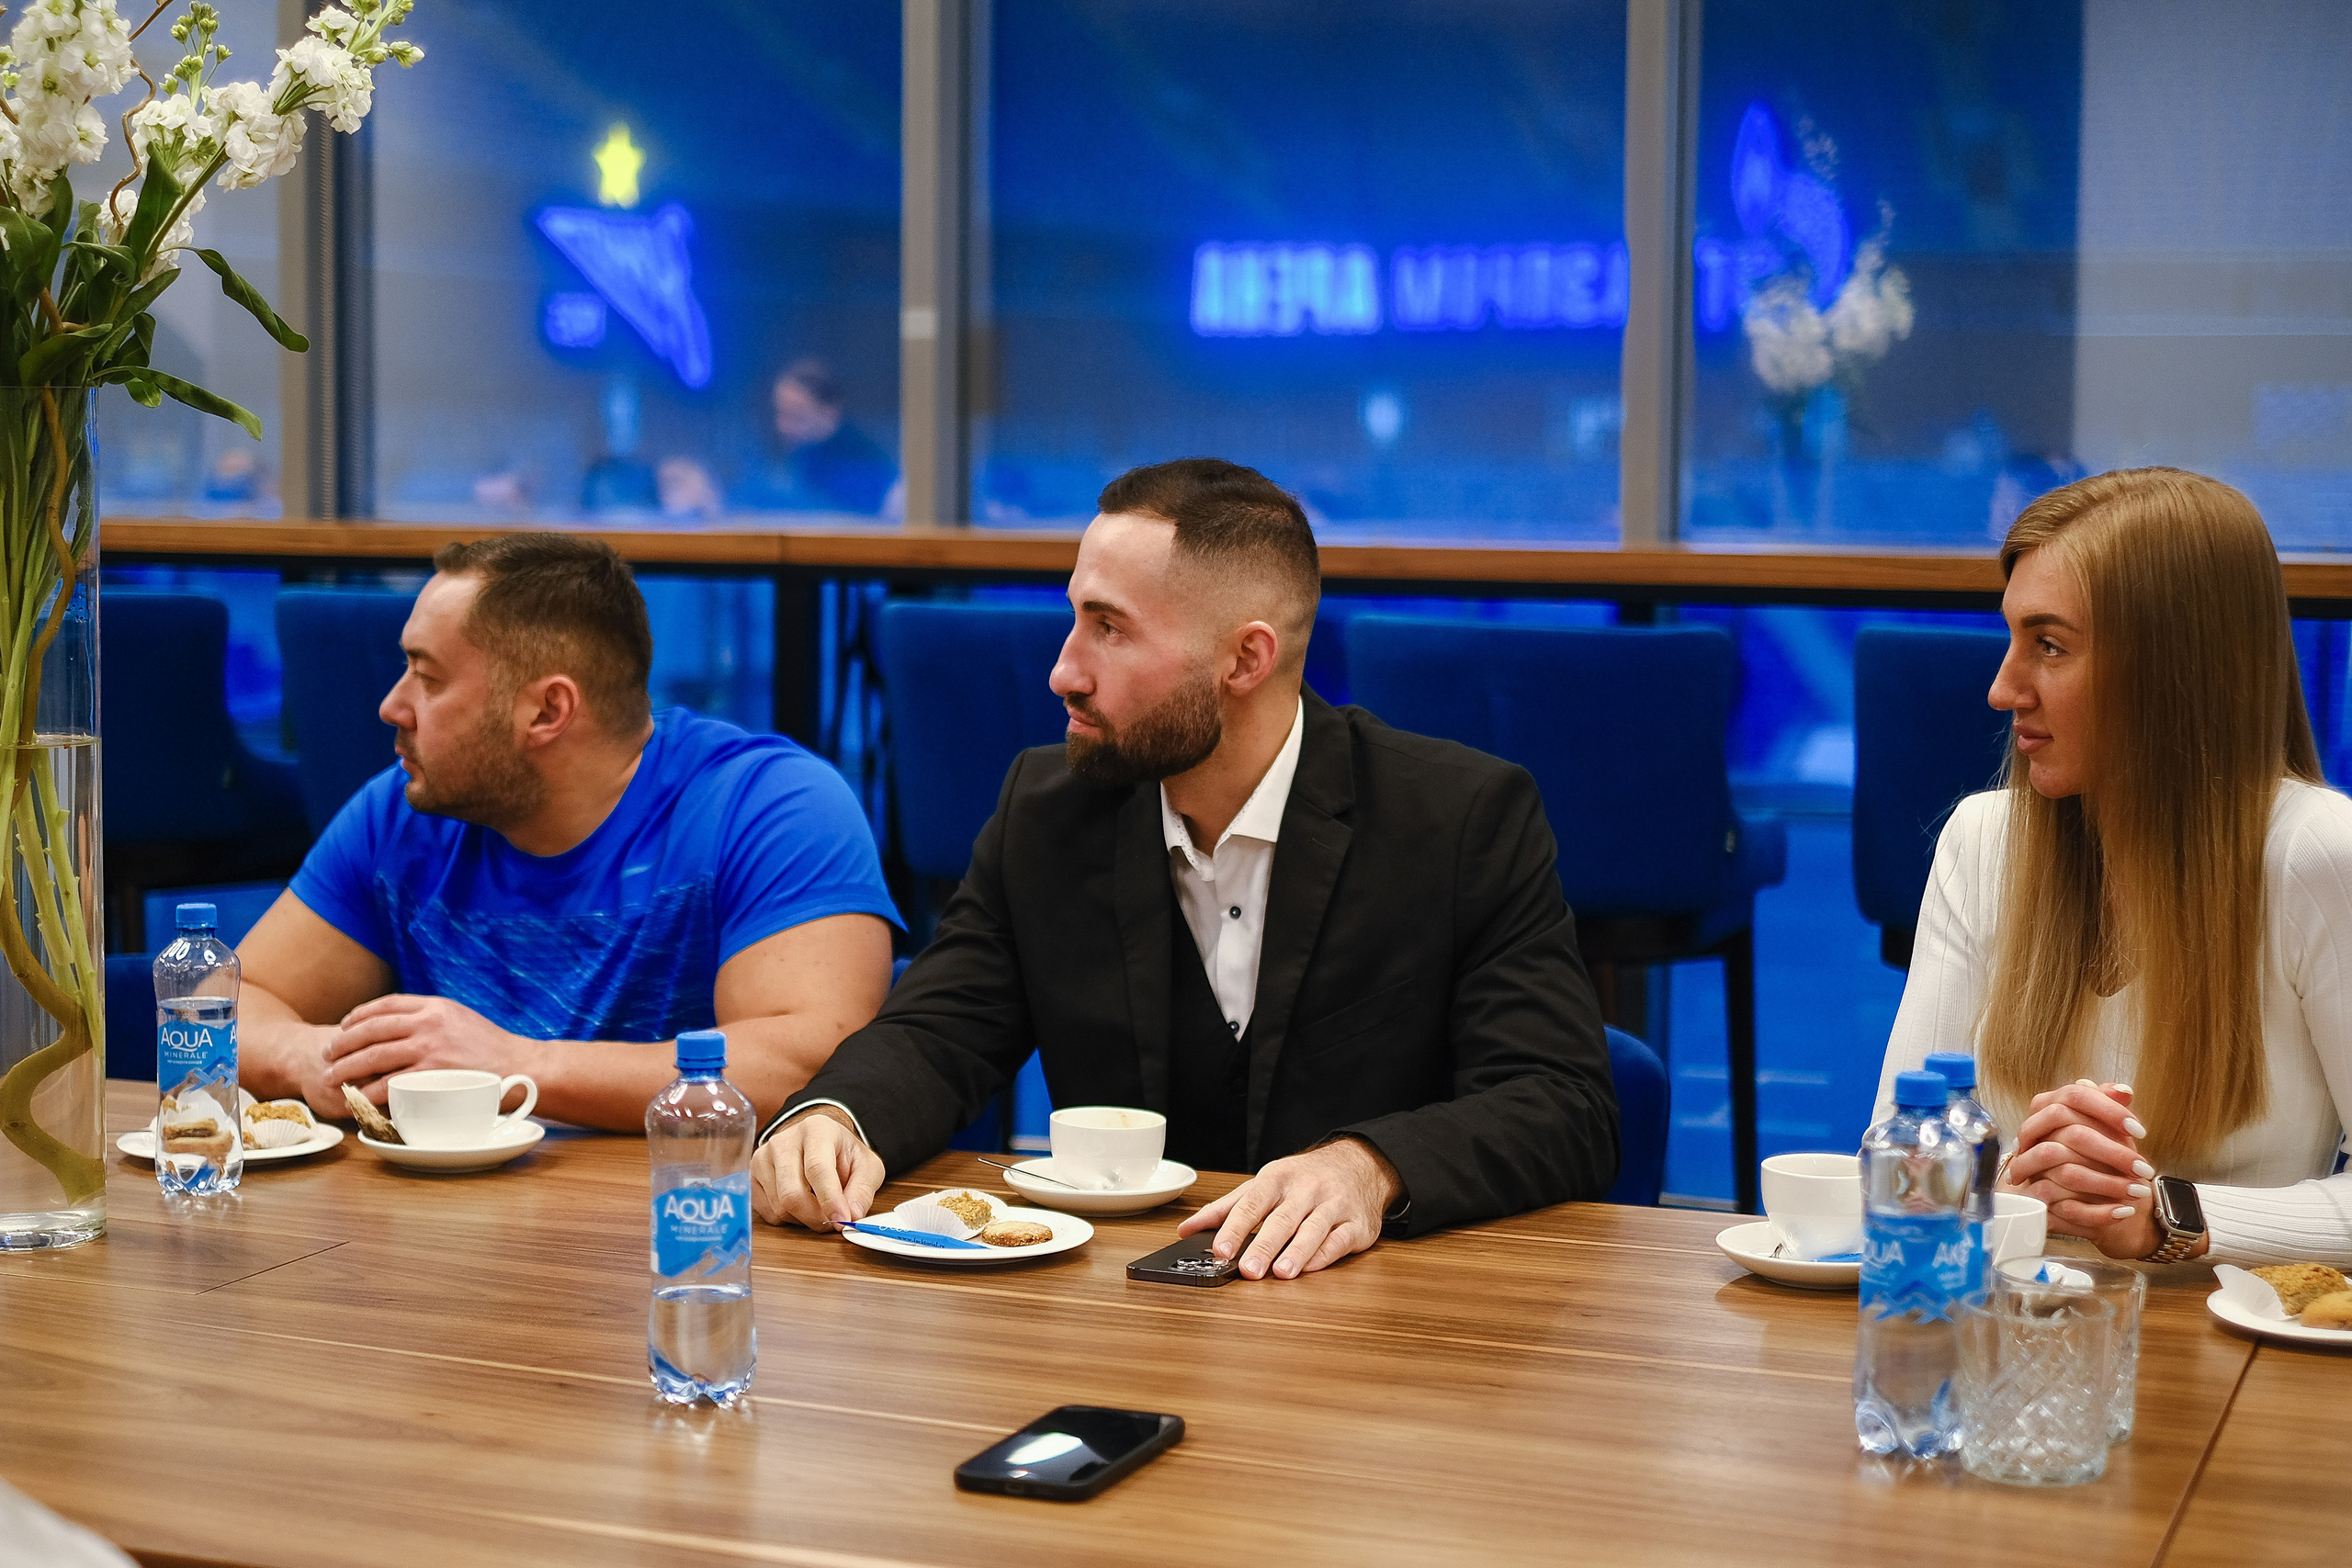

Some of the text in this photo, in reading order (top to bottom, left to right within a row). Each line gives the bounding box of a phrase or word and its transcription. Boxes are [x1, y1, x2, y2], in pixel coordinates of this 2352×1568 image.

[161, 1027, 213, 1052] AQUA
[164, 1051, 207, 1059] MINERALE
[663, 1194, 735, 1224] AQUA
